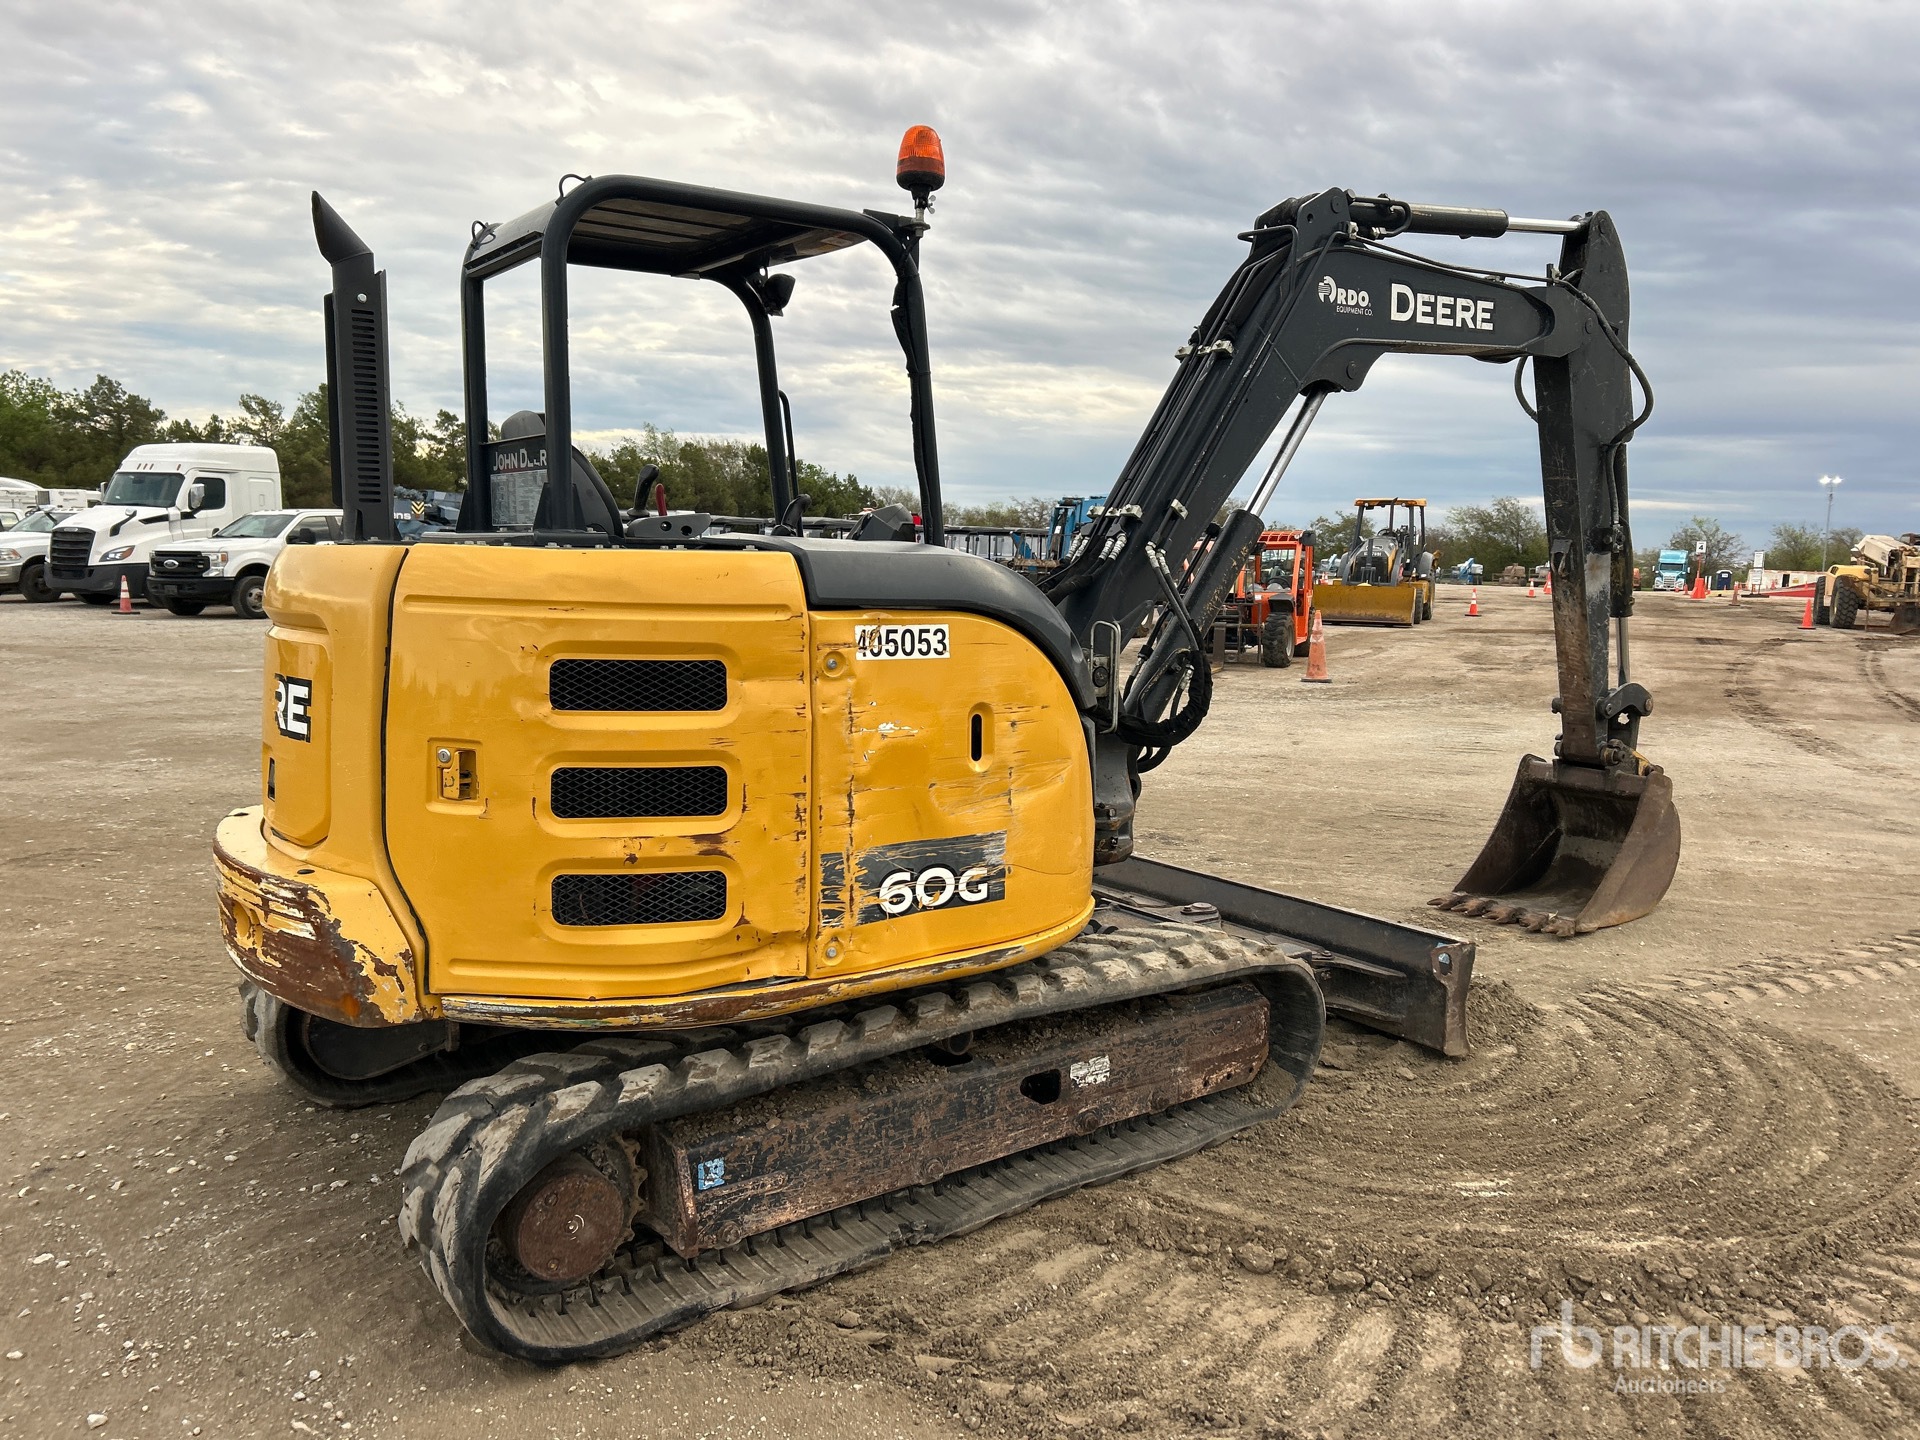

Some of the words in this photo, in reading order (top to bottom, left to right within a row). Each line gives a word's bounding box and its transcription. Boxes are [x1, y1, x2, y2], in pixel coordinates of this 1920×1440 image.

[1337, 288, 1370, 307] RDO
[1390, 283, 1495, 331] DEERE
[1336, 306, 1364, 315] EQUIPMENT
[493, 451, 518, 471] JOHN
[858, 628, 947, 657] 405053
[879, 867, 988, 914] 60G
